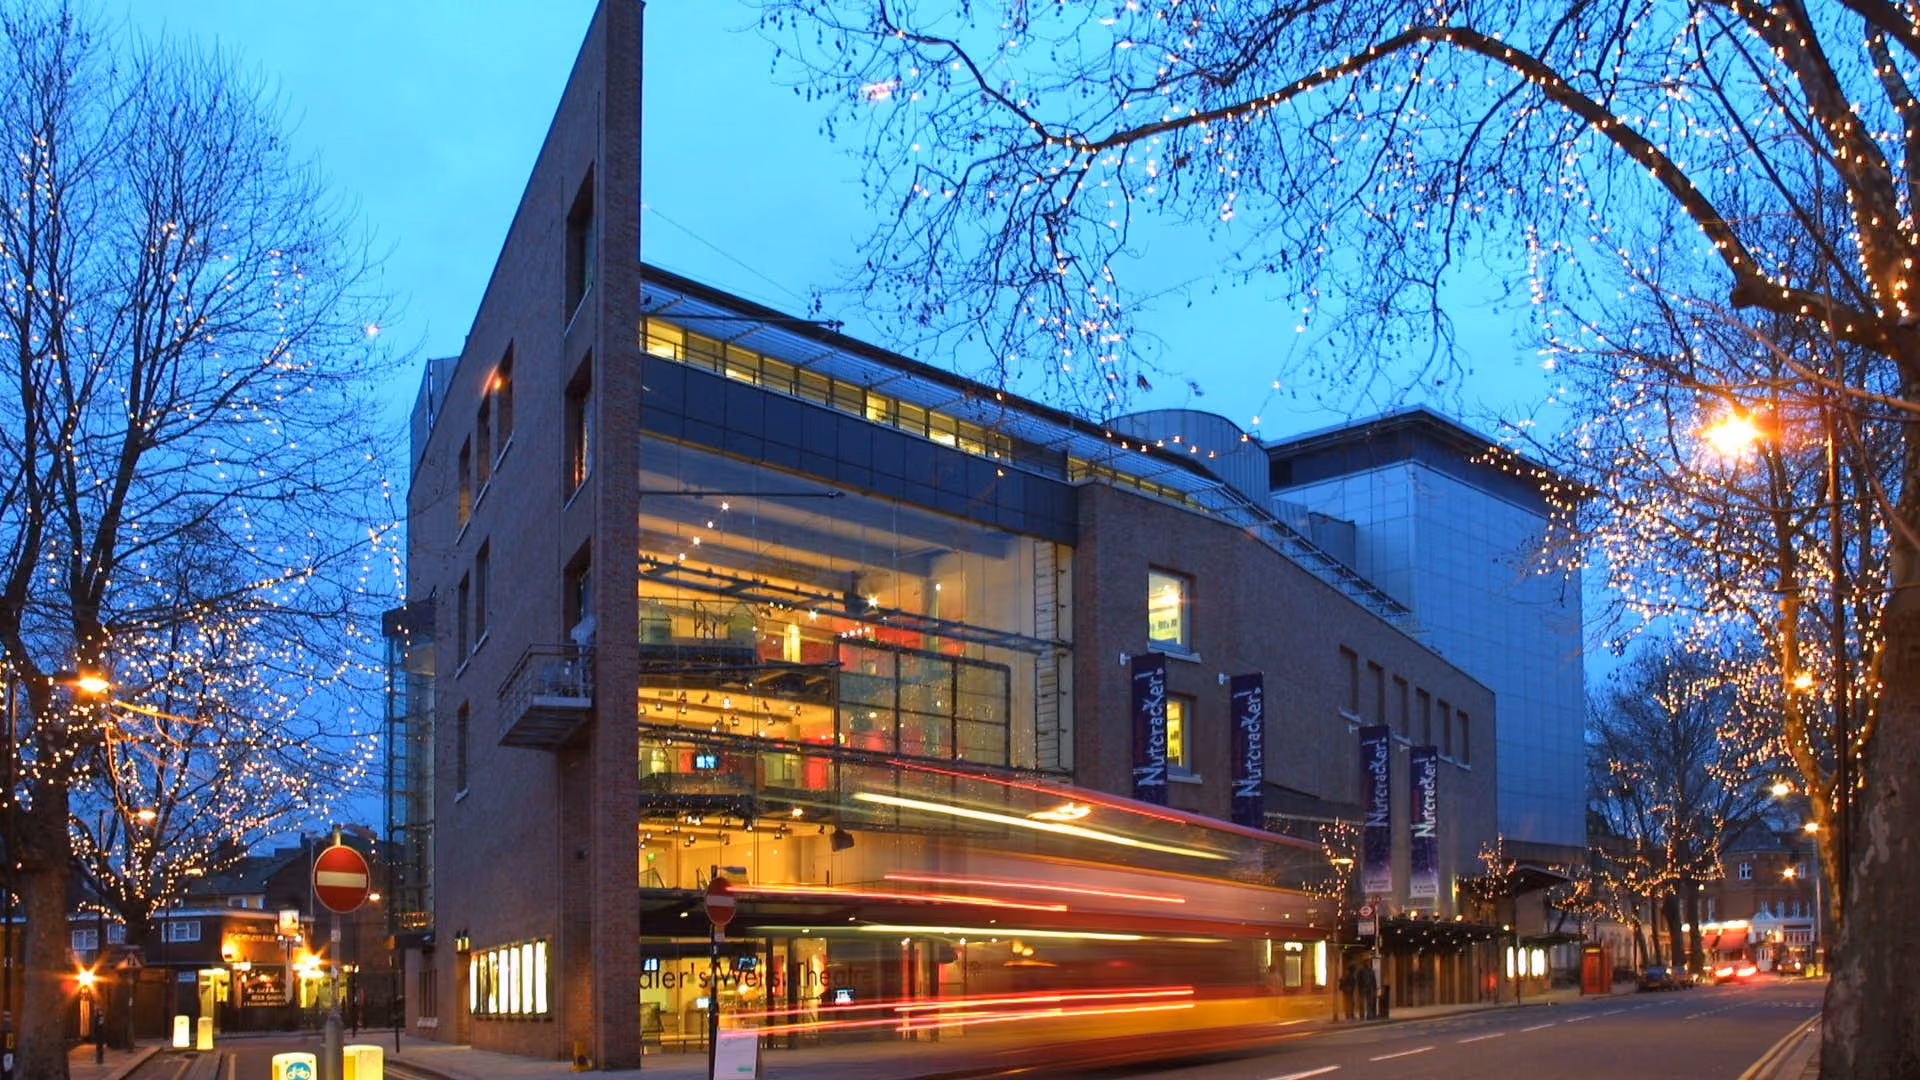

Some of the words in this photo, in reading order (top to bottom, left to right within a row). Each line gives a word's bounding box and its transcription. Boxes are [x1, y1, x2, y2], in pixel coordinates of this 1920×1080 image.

[1133, 667, 1165, 785] Nutcracker!
[1232, 687, 1262, 797] Nutcracker!
[1361, 737, 1388, 827] Nutcracker!
[1410, 755, 1437, 838] Nutcracker!
[710, 957, 780, 988] Wels
